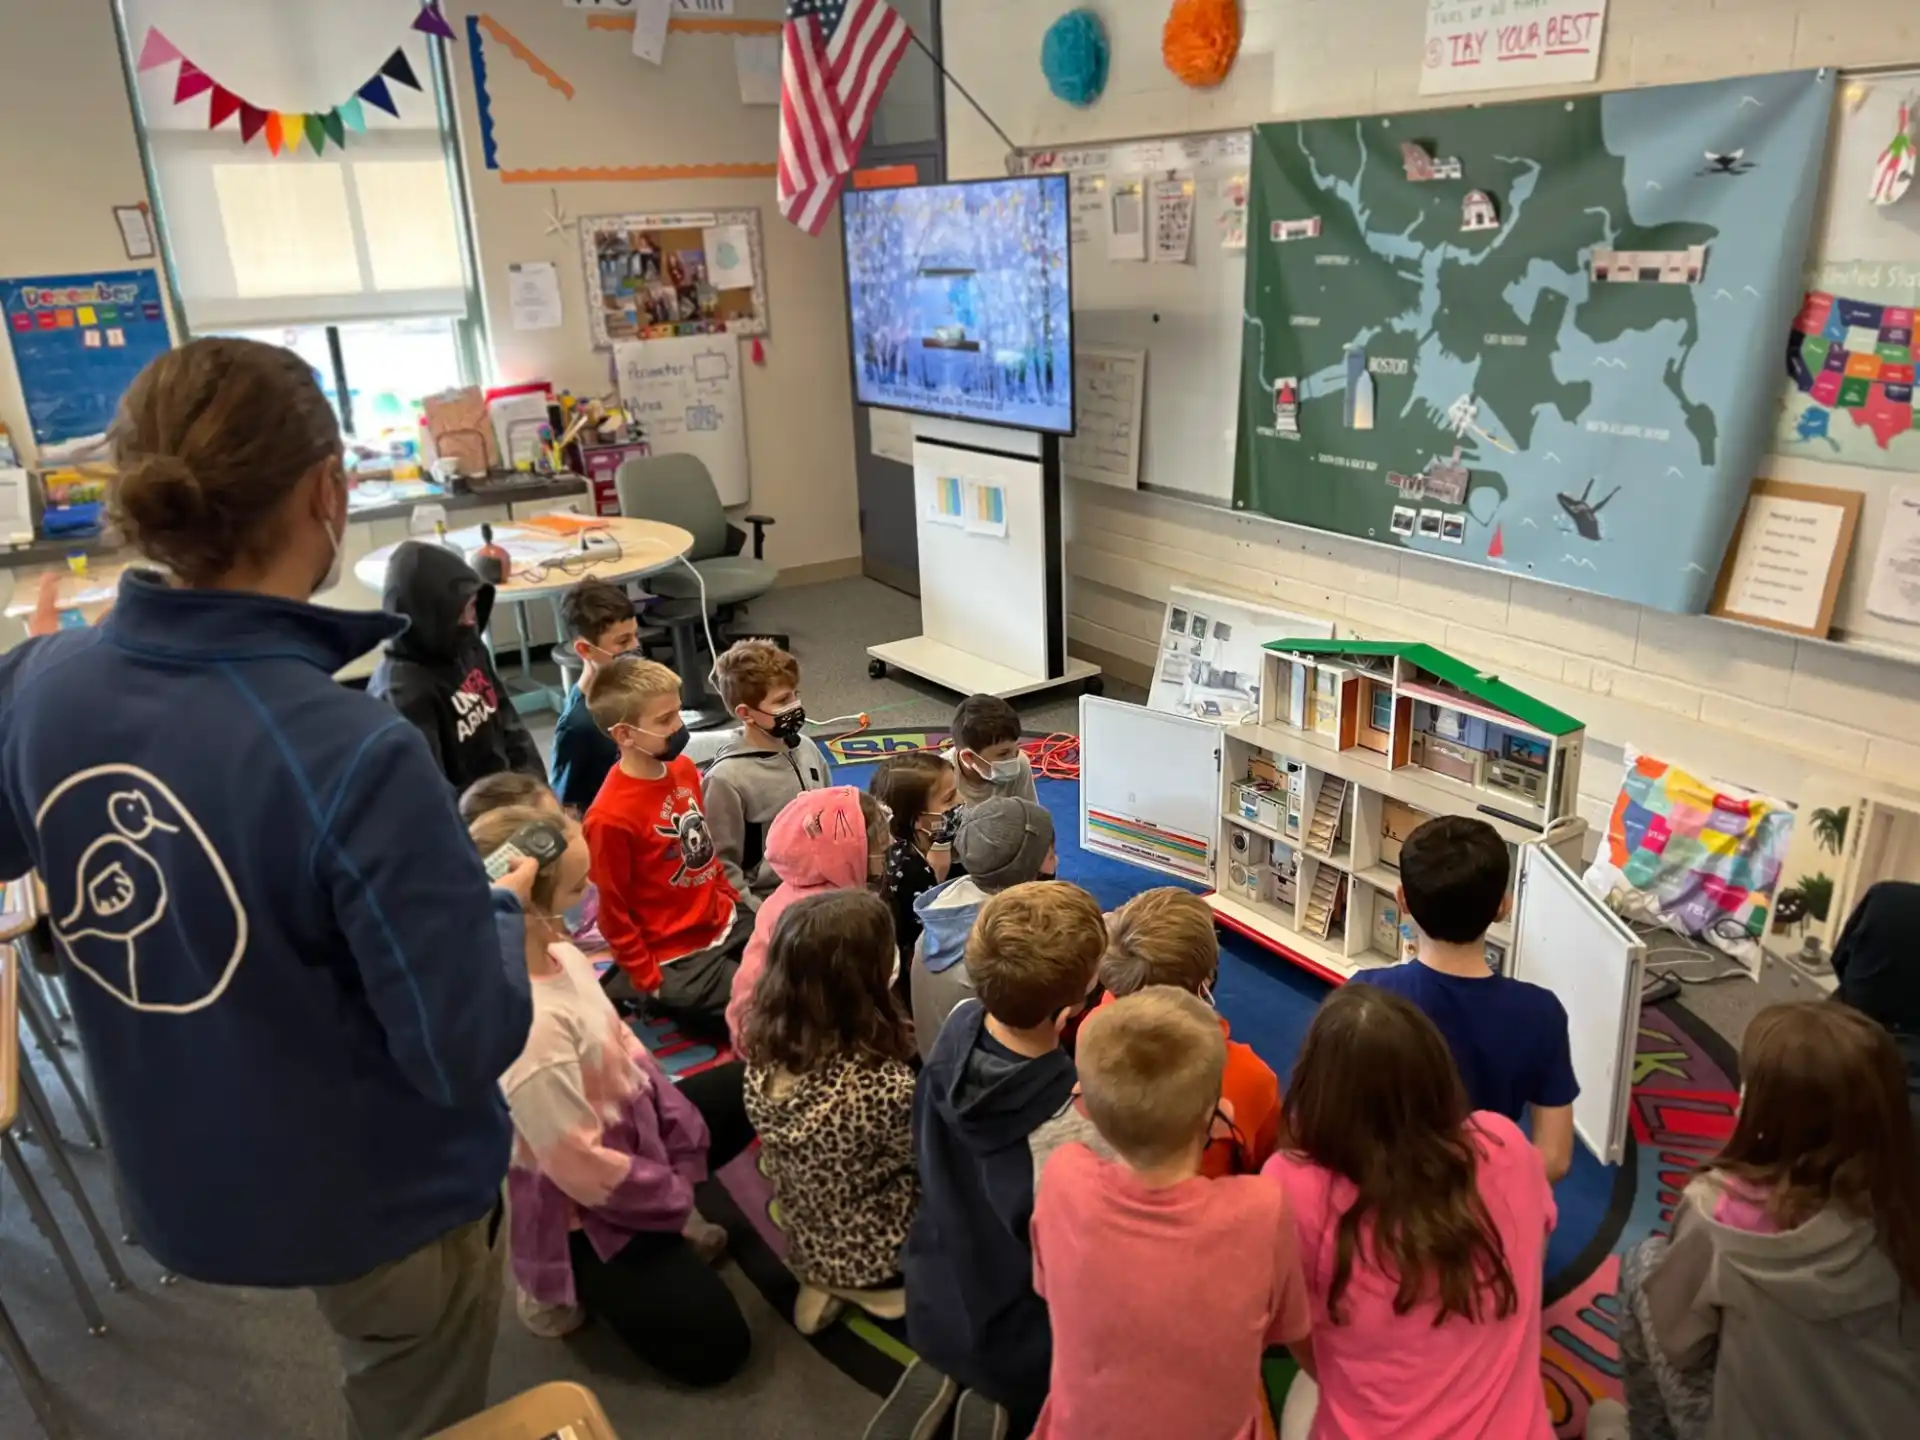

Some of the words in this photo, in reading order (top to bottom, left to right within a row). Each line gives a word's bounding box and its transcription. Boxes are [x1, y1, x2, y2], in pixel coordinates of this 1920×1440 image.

[1447, 30, 1487, 62] TRY
[1497, 22, 1541, 52] YOUR
[1545, 13, 1599, 47] BEST
[22, 282, 138, 309] December
[1369, 356, 1408, 375] BOSTON
